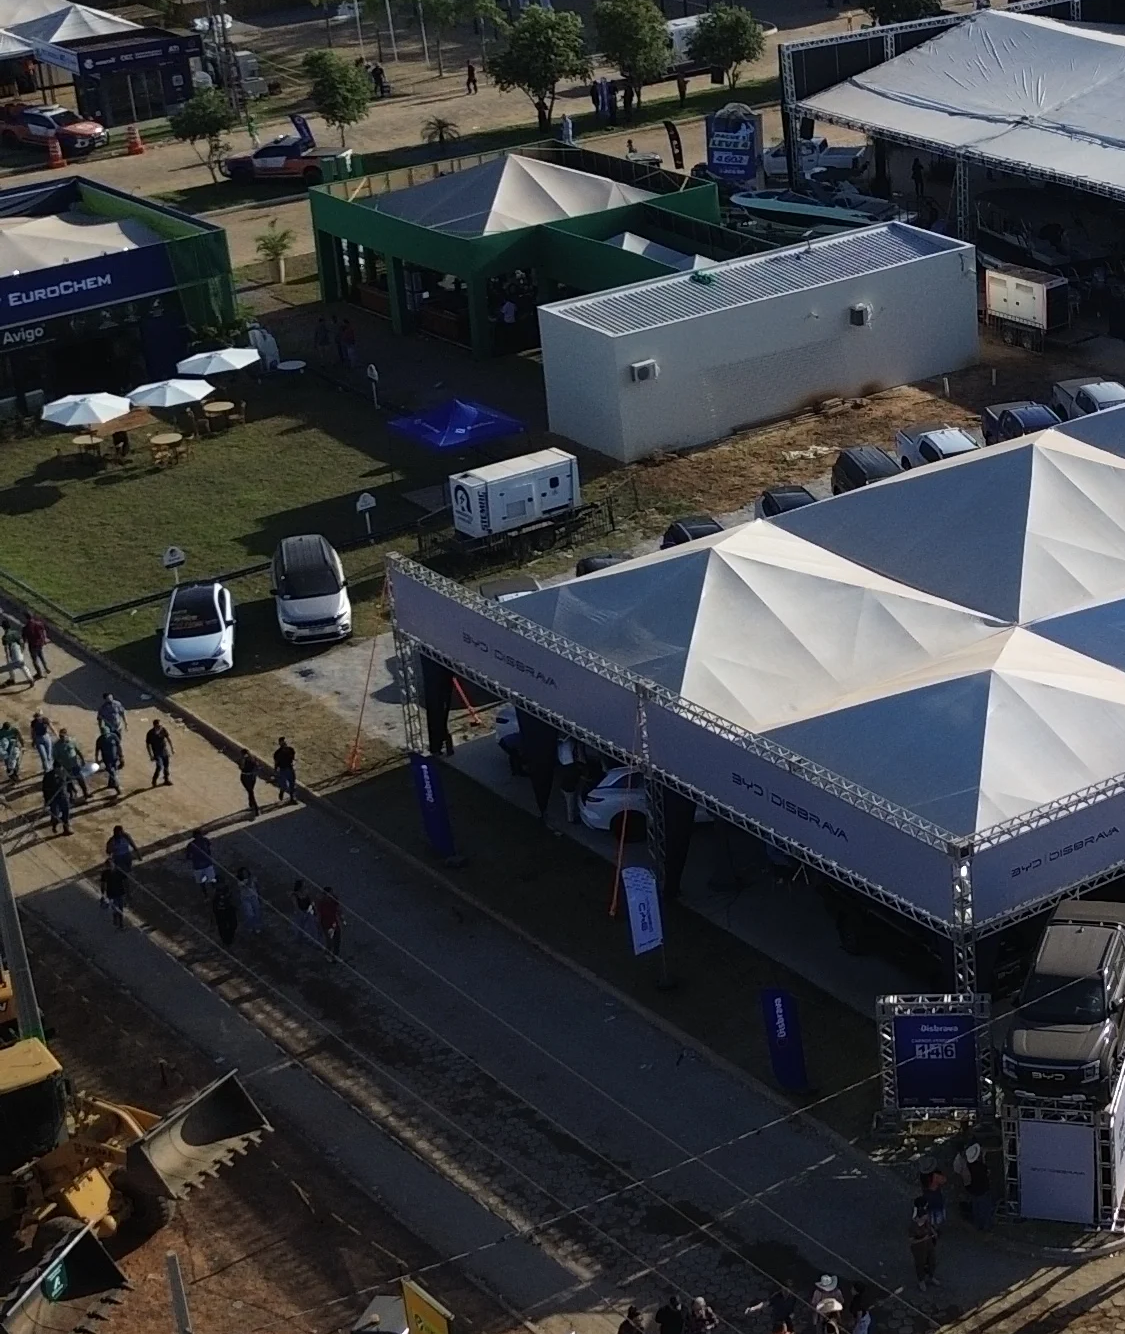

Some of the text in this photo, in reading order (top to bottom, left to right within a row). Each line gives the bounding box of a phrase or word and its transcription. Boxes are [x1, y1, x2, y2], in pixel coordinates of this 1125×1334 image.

[3, 326, 44, 346] Avigo
[462, 631, 559, 690] BYD DISBRAVA
[731, 772, 849, 843] BYD DISBRAVA
[1011, 826, 1120, 878] BYD DISBRAVA
[920, 1024, 959, 1033] Disbrava
[1031, 1071, 1066, 1081] BYD
